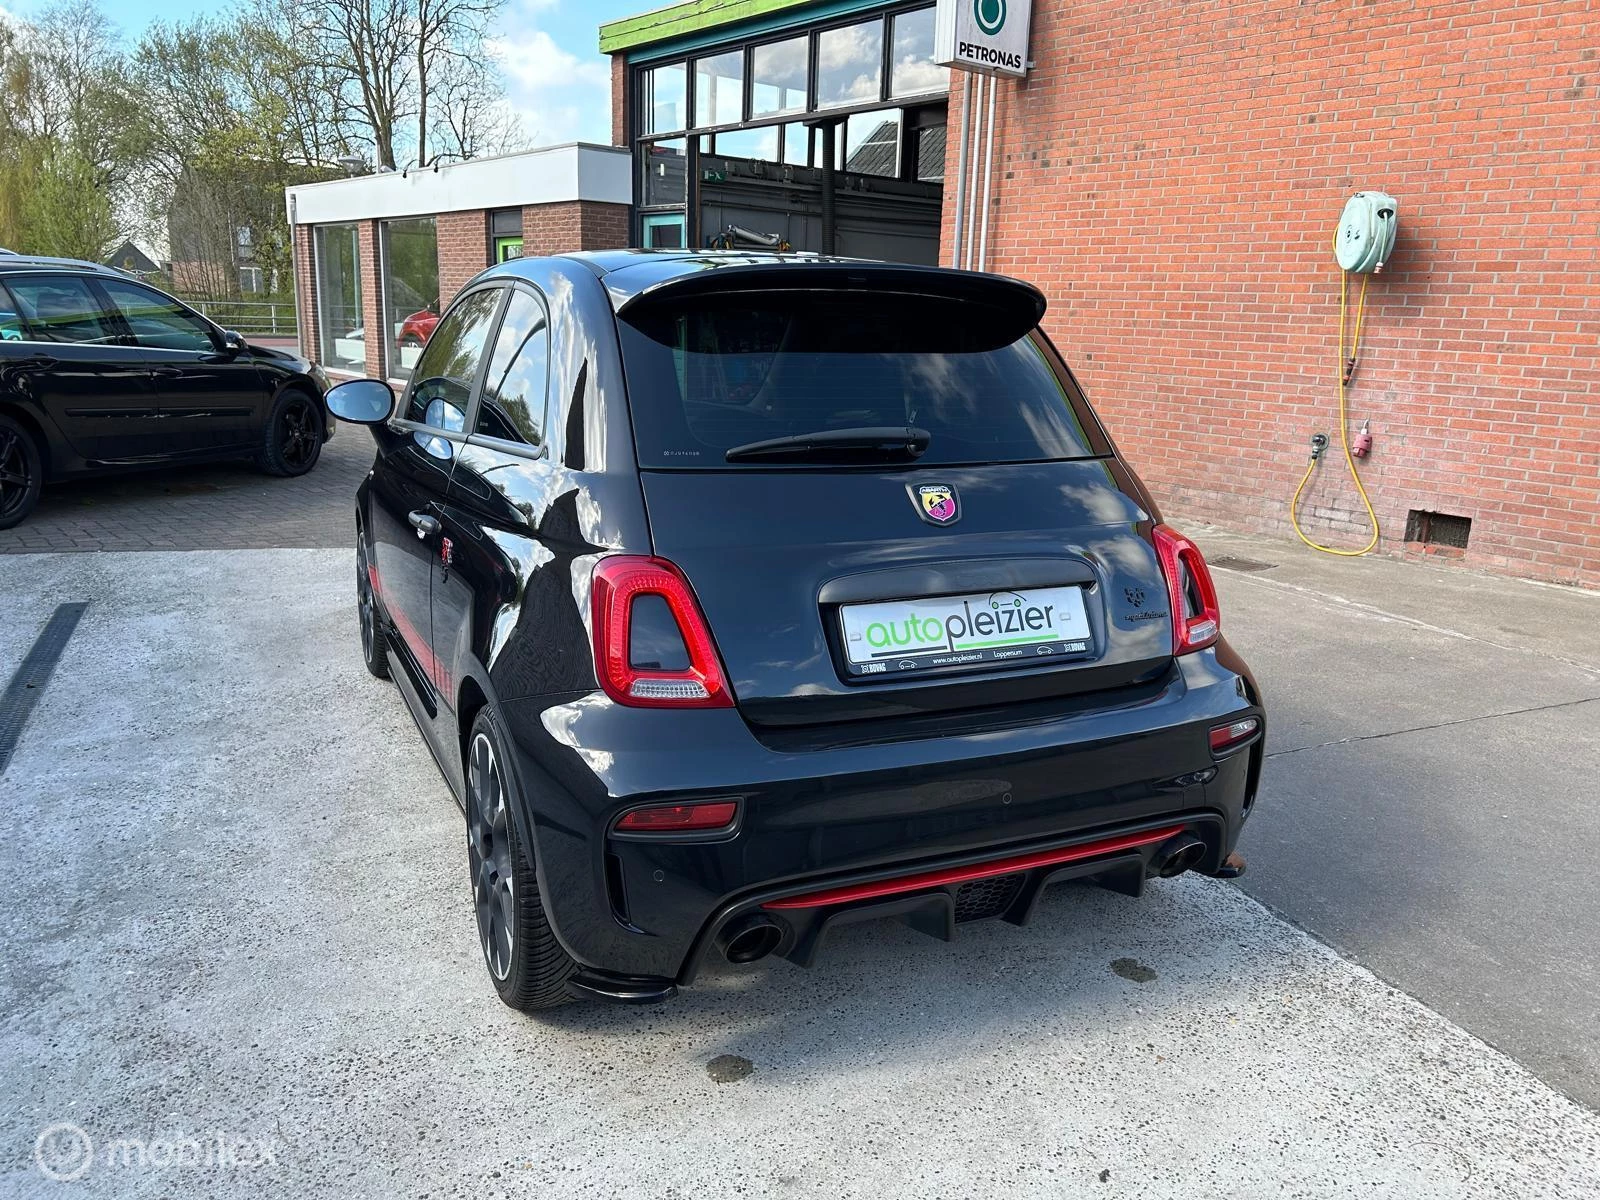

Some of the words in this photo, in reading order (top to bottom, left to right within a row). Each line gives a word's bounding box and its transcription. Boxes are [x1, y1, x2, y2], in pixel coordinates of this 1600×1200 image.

[959, 41, 1022, 69] PETRONAS
[866, 600, 1054, 652] autopleizier
[933, 652, 983, 664] www.autopleizier.nl
